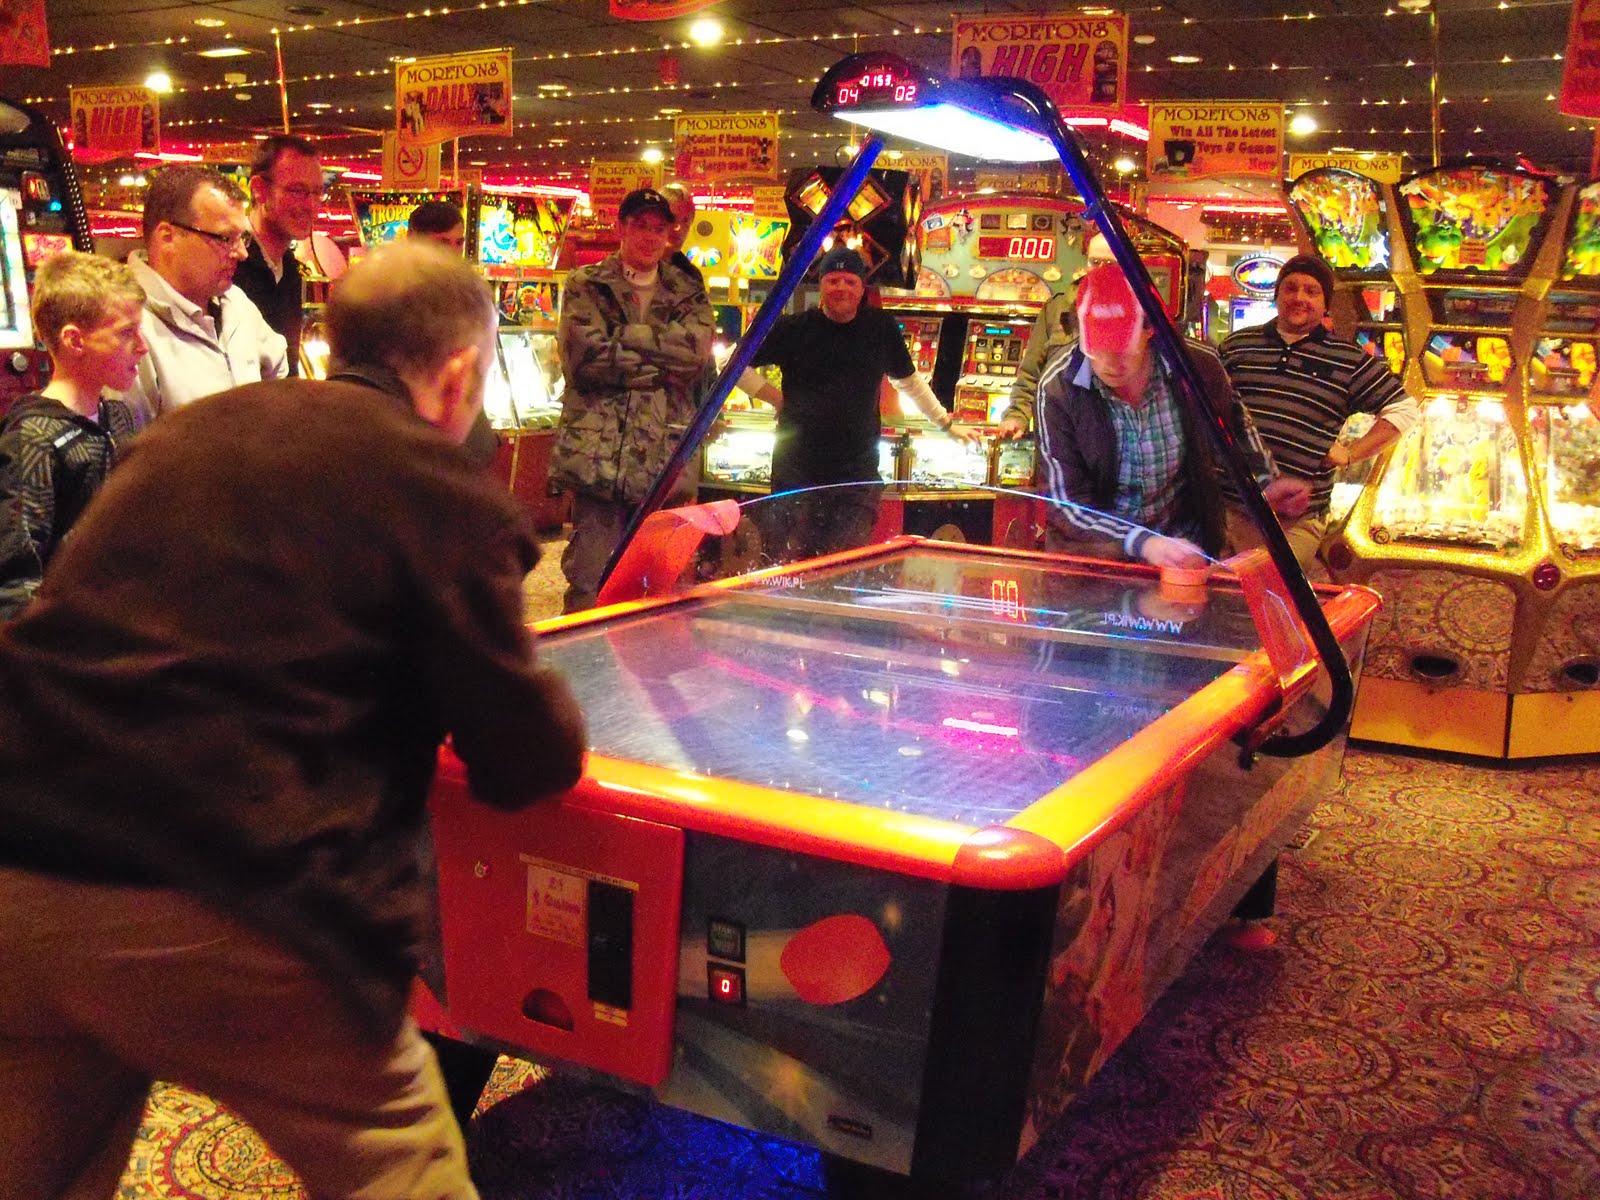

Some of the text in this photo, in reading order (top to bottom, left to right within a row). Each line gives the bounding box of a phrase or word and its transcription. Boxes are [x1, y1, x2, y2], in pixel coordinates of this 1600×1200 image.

[971, 21, 1109, 42] MORETONS
[991, 43, 1090, 83] HIGH
[406, 62, 500, 83] MORETONS
[838, 88, 859, 103] 04
[894, 85, 916, 101] 02
[1163, 108, 1271, 121] MORETONS
[686, 118, 767, 130] MORETONS
[1170, 126, 1193, 137] Win
[1196, 125, 1213, 137] All
[1216, 126, 1239, 138] The
[1197, 141, 1223, 154] Toys
[1238, 142, 1277, 154] Games
[721, 979, 731, 993] 0
